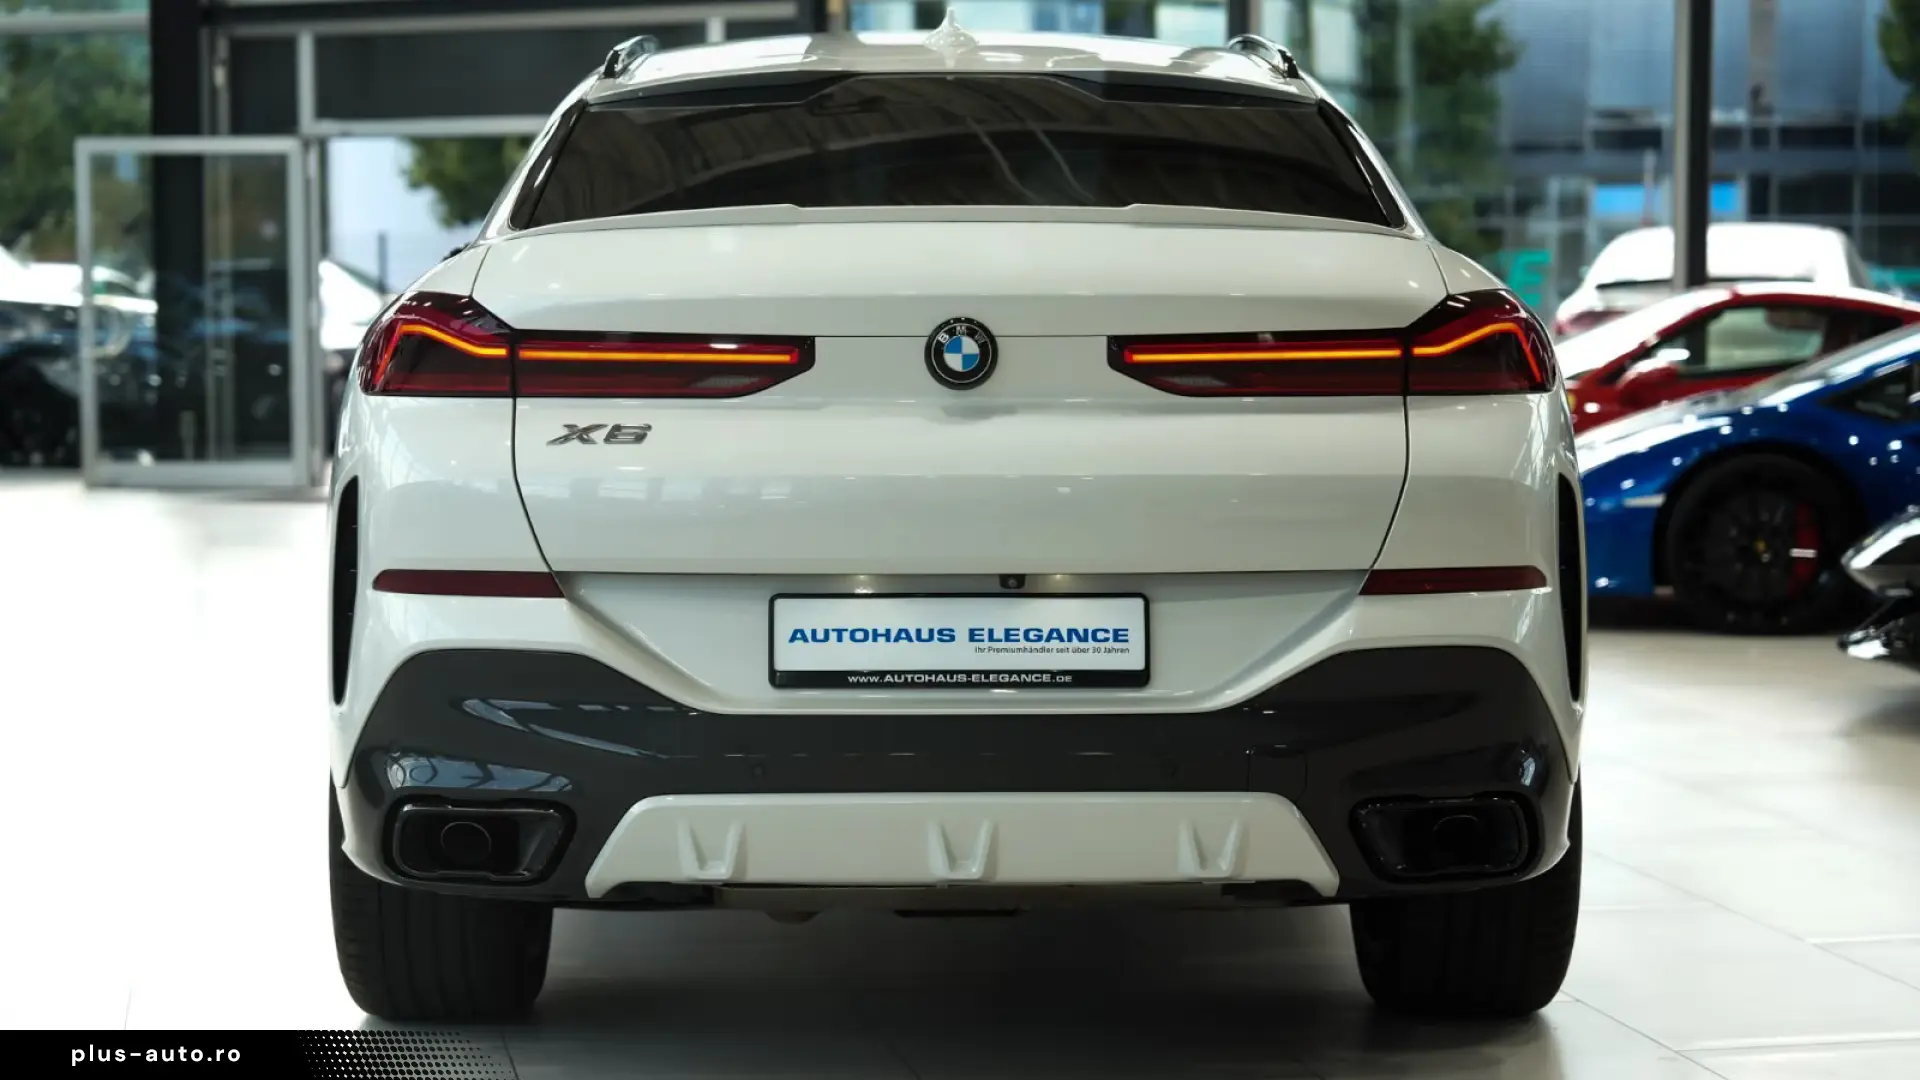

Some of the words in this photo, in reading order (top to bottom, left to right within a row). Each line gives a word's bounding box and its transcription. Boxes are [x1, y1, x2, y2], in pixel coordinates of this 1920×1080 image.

[938, 325, 985, 344] BMW
[546, 423, 652, 446] X6
[788, 627, 956, 643] AUTOHAUS
[968, 627, 1130, 643] ELEGANCE
[975, 646, 986, 654] Ihr
[988, 646, 1054, 654] Premiumhändler
[1056, 646, 1070, 654] seit
[1072, 646, 1090, 654] über
[1092, 646, 1101, 654] 30
[1103, 646, 1130, 654] Jahren
